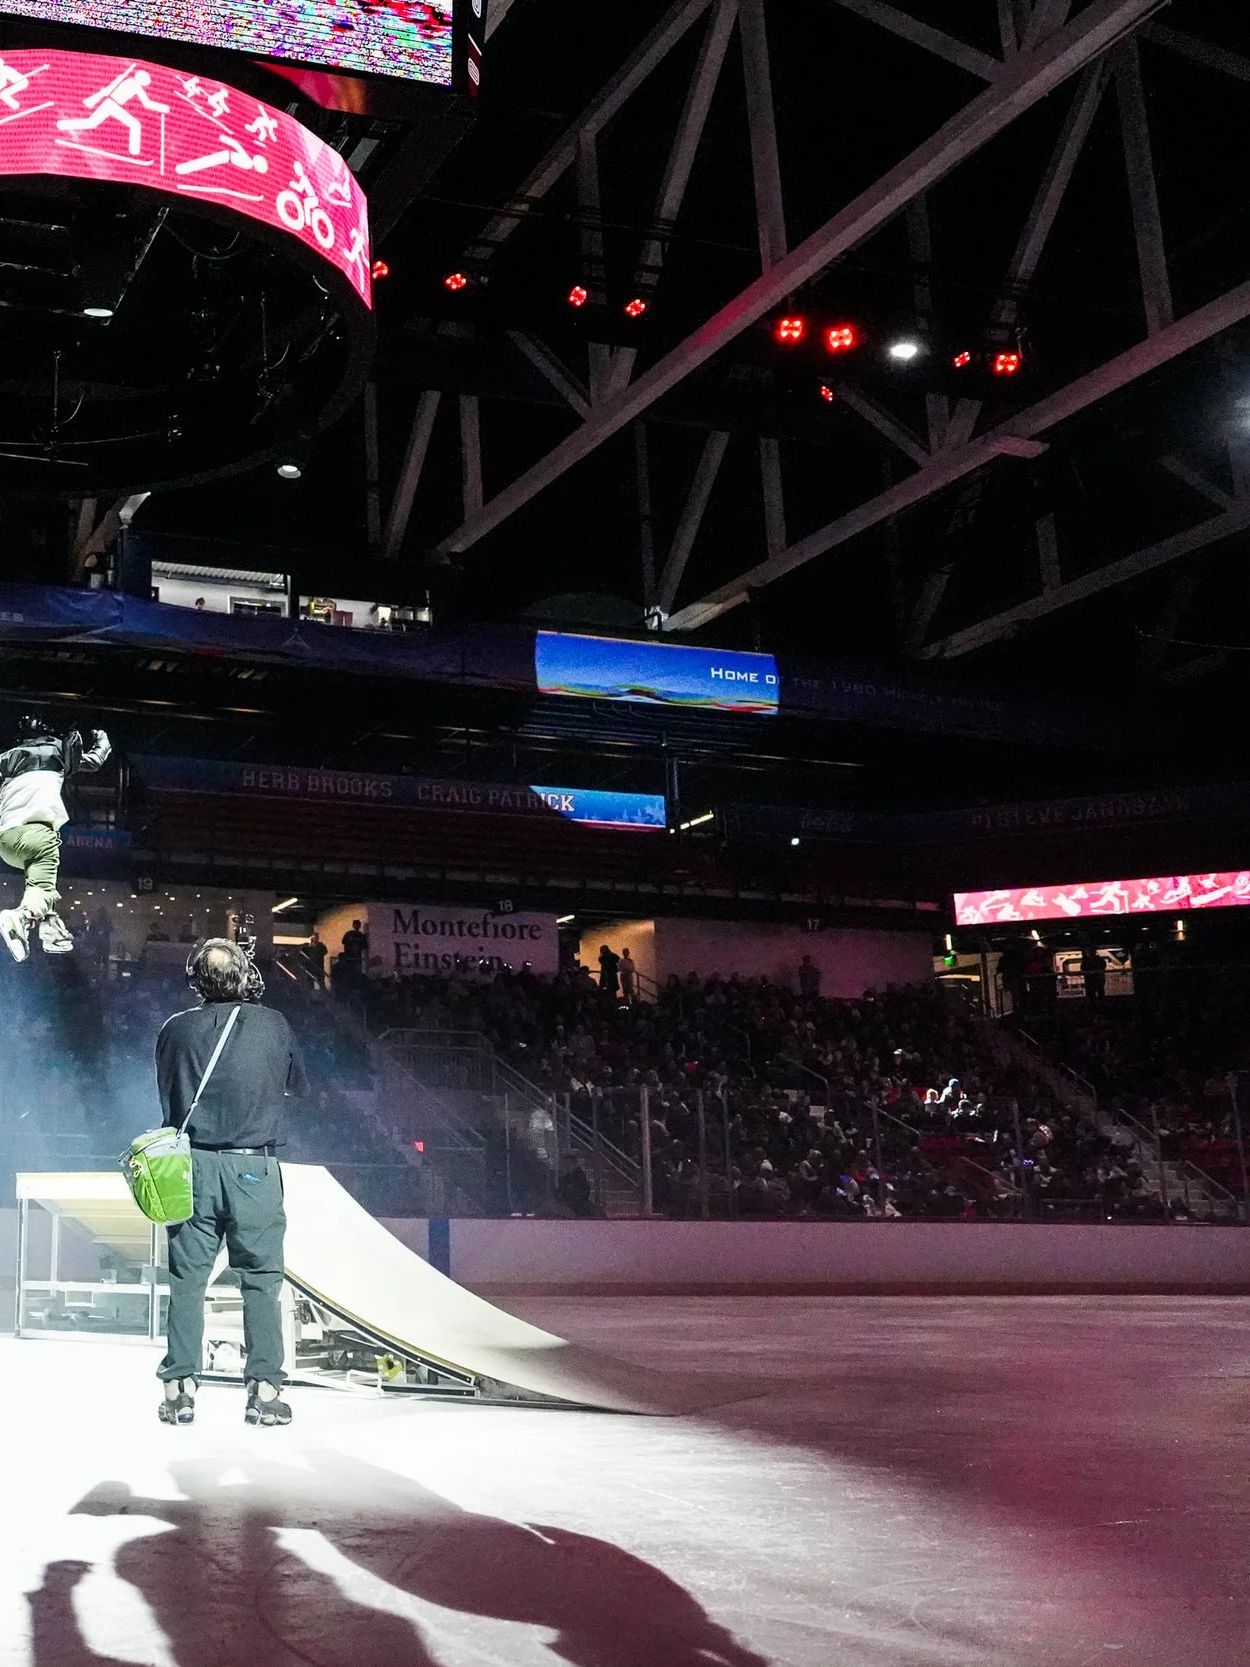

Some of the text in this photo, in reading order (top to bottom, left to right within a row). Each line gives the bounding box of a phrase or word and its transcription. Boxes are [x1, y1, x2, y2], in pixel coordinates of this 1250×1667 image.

[710, 667, 759, 684] HOME
[241, 768, 393, 798] HERB BROOKS
[417, 783, 575, 812] CRAIG PATRICK
[137, 876, 154, 890] 19
[500, 900, 514, 912] 18
[392, 908, 543, 940] Montefiore
[394, 942, 503, 970] Einstein
